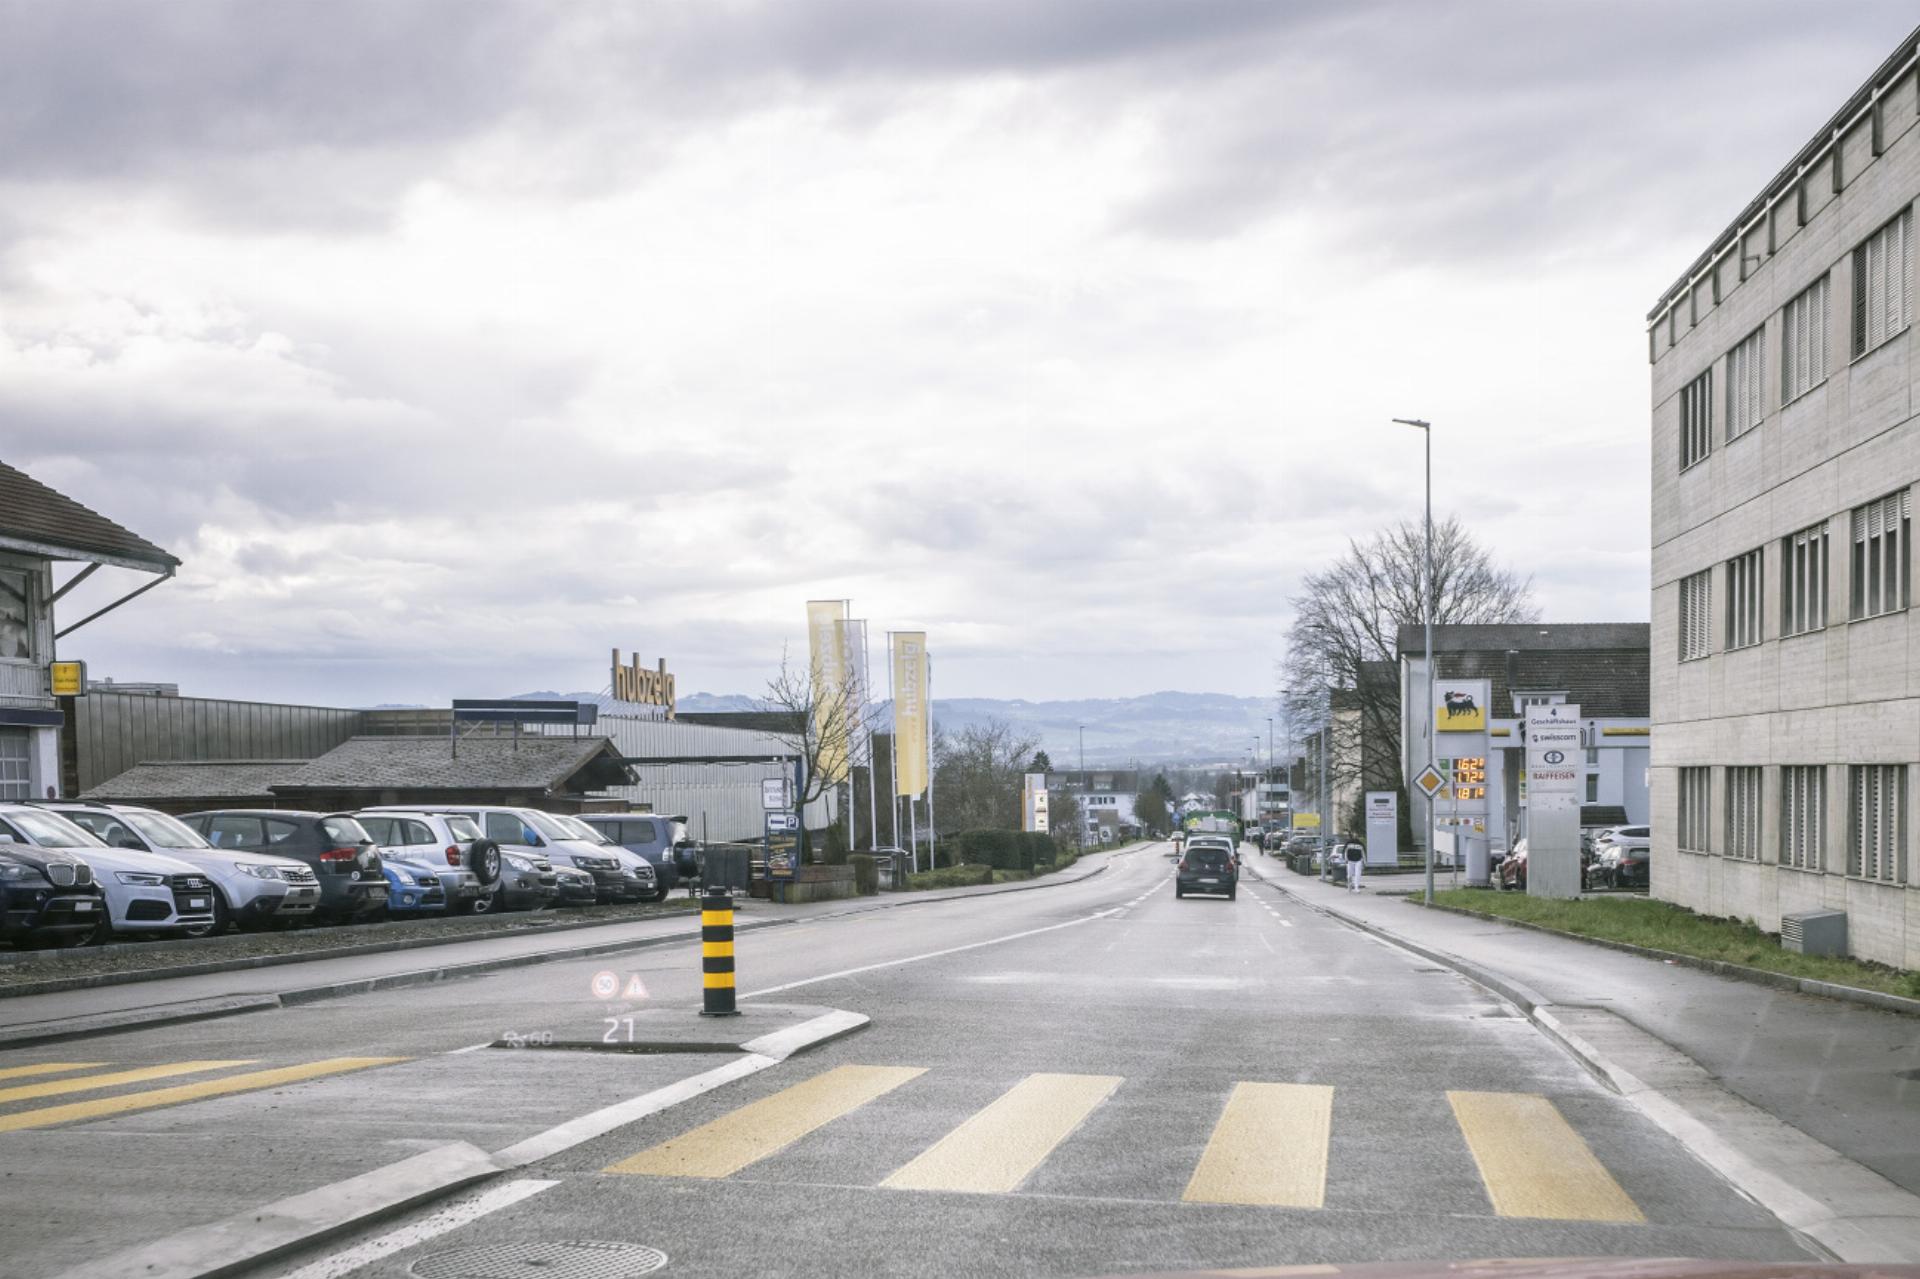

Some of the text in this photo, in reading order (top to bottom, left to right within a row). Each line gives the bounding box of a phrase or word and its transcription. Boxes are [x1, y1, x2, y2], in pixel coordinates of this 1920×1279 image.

[611, 648, 675, 720] hubzelg
[1551, 708, 1557, 716] 4
[1533, 772, 1575, 780] RAIFFEISEN
[603, 1018, 634, 1043] 21
